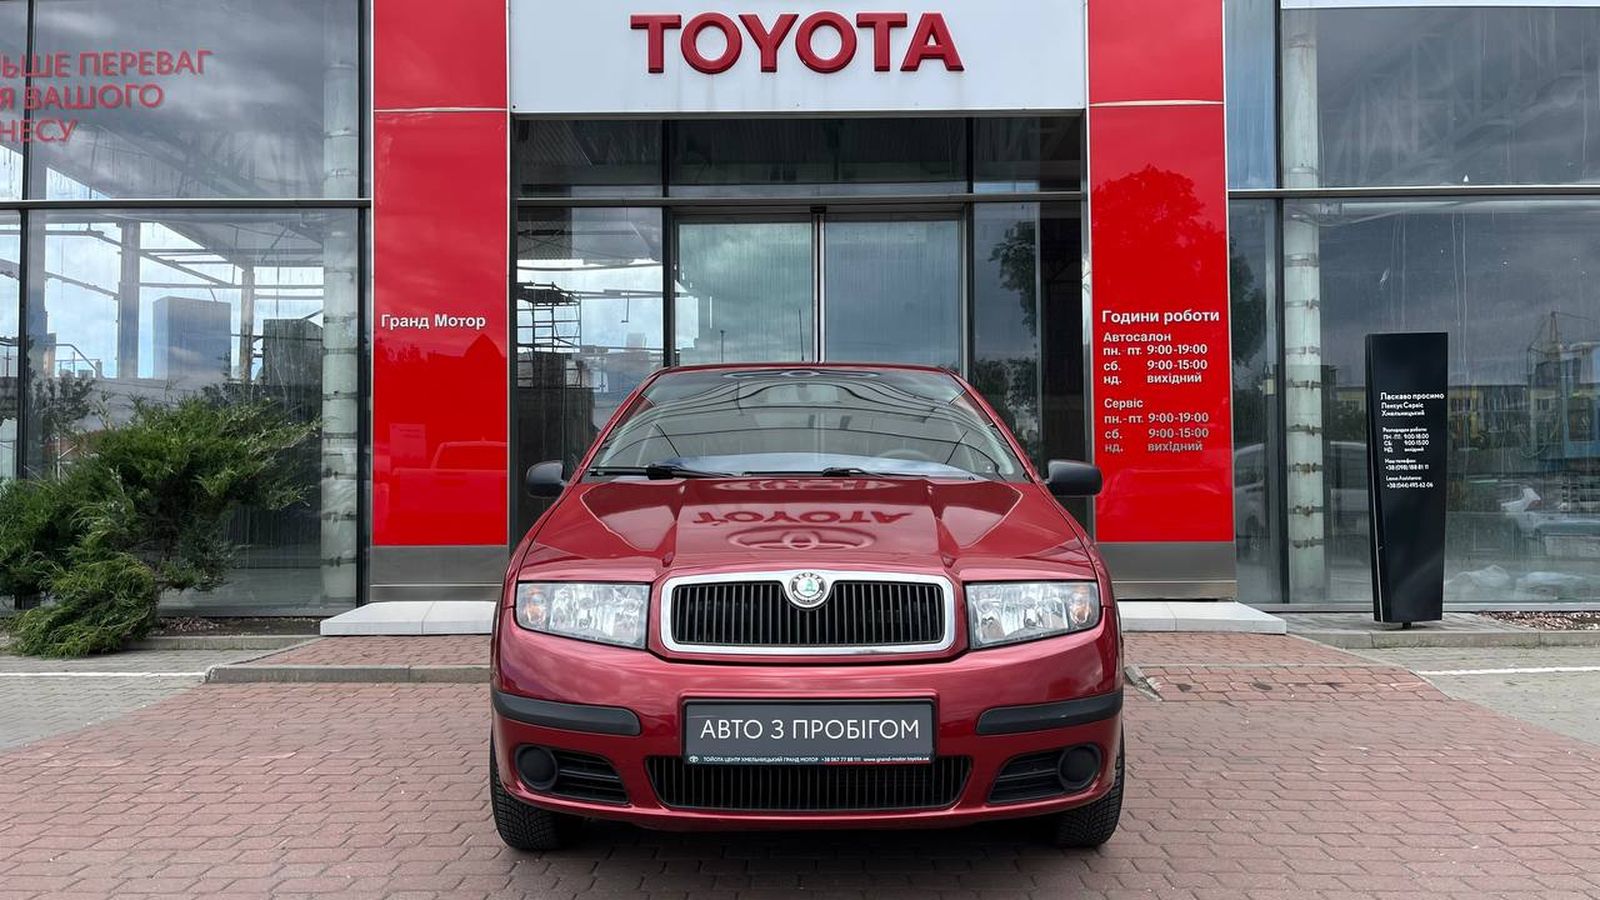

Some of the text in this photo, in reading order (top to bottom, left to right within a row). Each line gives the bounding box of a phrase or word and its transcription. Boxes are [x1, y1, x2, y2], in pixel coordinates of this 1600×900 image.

[630, 11, 965, 74] TOYOTA
[80, 49, 213, 76] ПЕРЕВАГ
[25, 83, 164, 110] ВАШОГО
[381, 313, 487, 331] Гранд Мотор
[1101, 309, 1220, 326] Години роботи
[1103, 332, 1172, 342] Автосалон
[1146, 343, 1208, 355] 9:00-19:00
[1103, 360, 1208, 371] сб. 9:00-15:00
[1103, 373, 1202, 385] нд. вихідний
[1104, 398, 1143, 410] Сервіс
[1147, 413, 1209, 423] 9:00-19:00
[1104, 428, 1209, 440] сб. 9:00-15:00
[1147, 441, 1203, 453] вихідний
[700, 719, 919, 739] АВТО З ПРОБІГОМ
